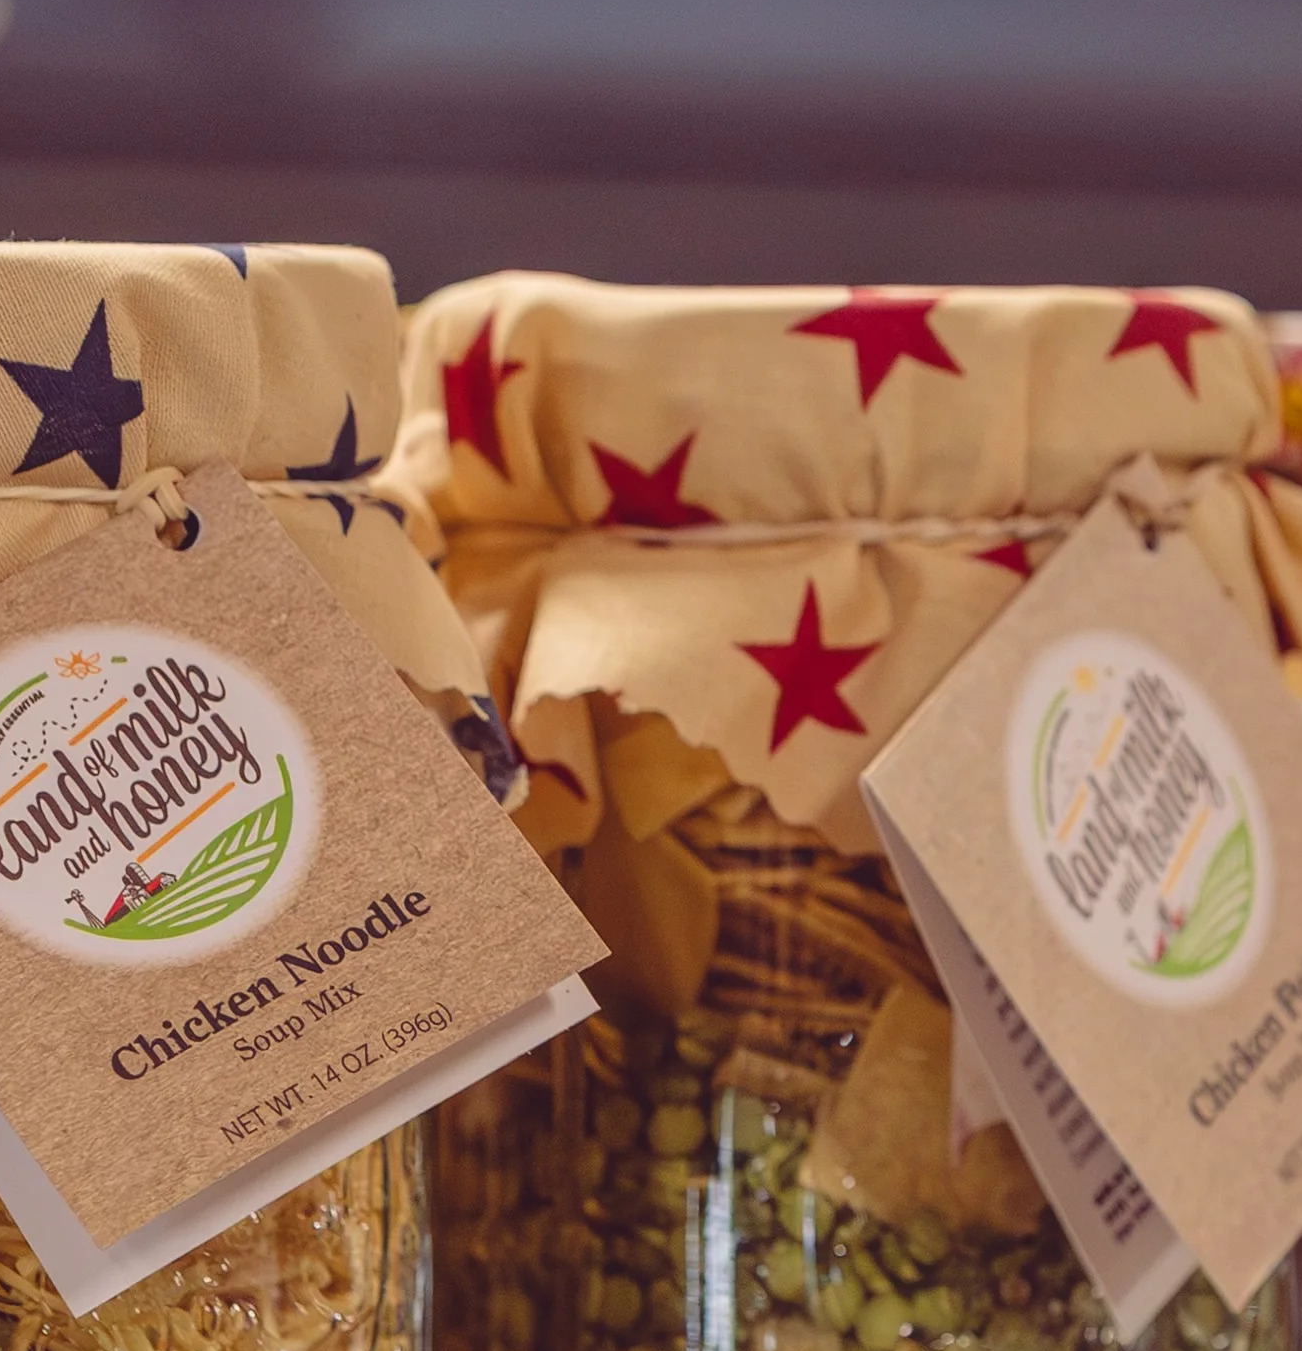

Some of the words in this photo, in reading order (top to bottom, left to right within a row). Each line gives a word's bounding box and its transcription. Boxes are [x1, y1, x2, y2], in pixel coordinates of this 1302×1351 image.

[2, 689, 46, 731] ESSENTIAL
[83, 737, 120, 779] of
[107, 657, 227, 773] milk
[63, 825, 111, 879] and
[95, 712, 262, 852] honey
[1046, 771, 1129, 923] land
[1127, 730, 1226, 886] honey
[110, 975, 285, 1081] Chicken
[275, 890, 432, 988] Noodle
[232, 1012, 306, 1063] Soup
[302, 980, 365, 1023] Mix
[220, 1105, 267, 1145] NET
[264, 1083, 314, 1117] WT.
[310, 1063, 343, 1091] 14
[340, 1043, 385, 1075] OZ.
[381, 1001, 454, 1054] (396g)
[1188, 1011, 1286, 1129] Chicken
